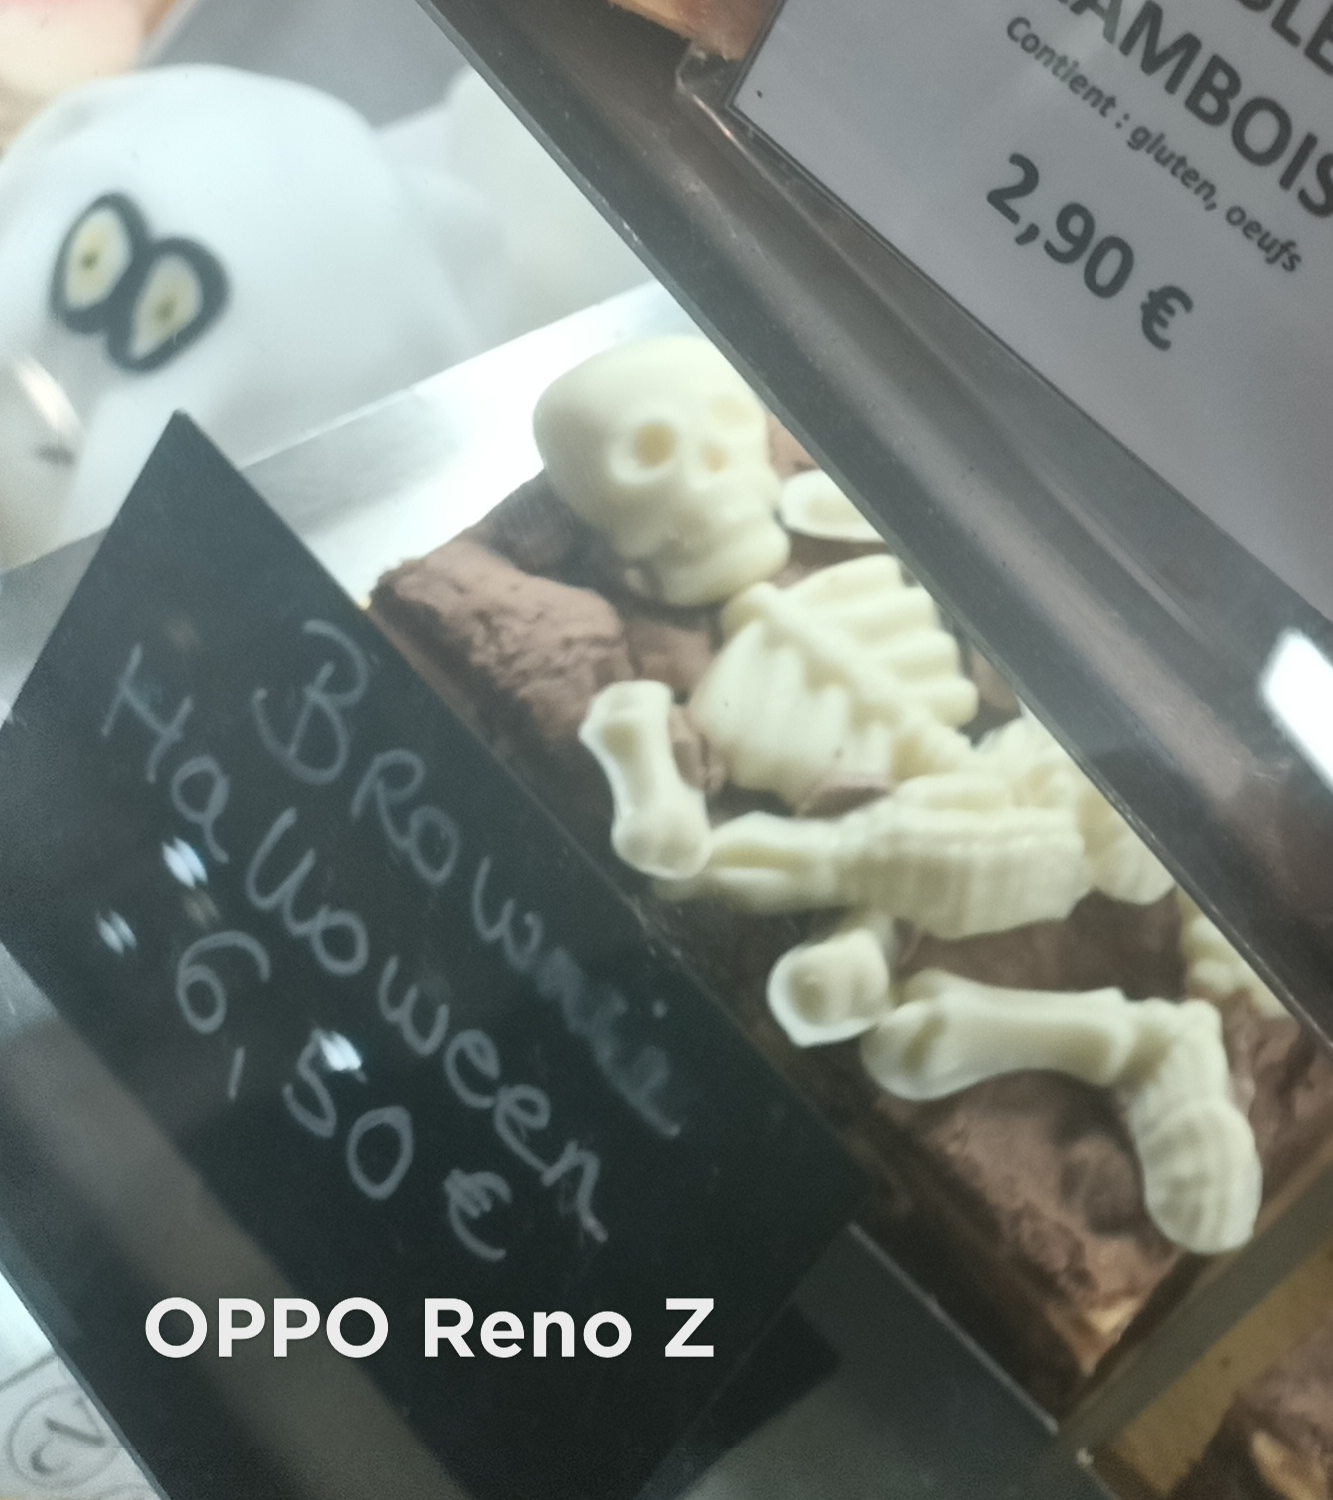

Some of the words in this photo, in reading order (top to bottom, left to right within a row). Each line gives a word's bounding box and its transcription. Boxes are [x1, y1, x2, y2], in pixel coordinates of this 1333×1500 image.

[985, 152, 1136, 300] 2,90
[1139, 284, 1194, 352] €
[1005, 15, 1118, 118] Contient
[1126, 123, 1220, 213] gluten,
[1224, 204, 1304, 273] oeufs
